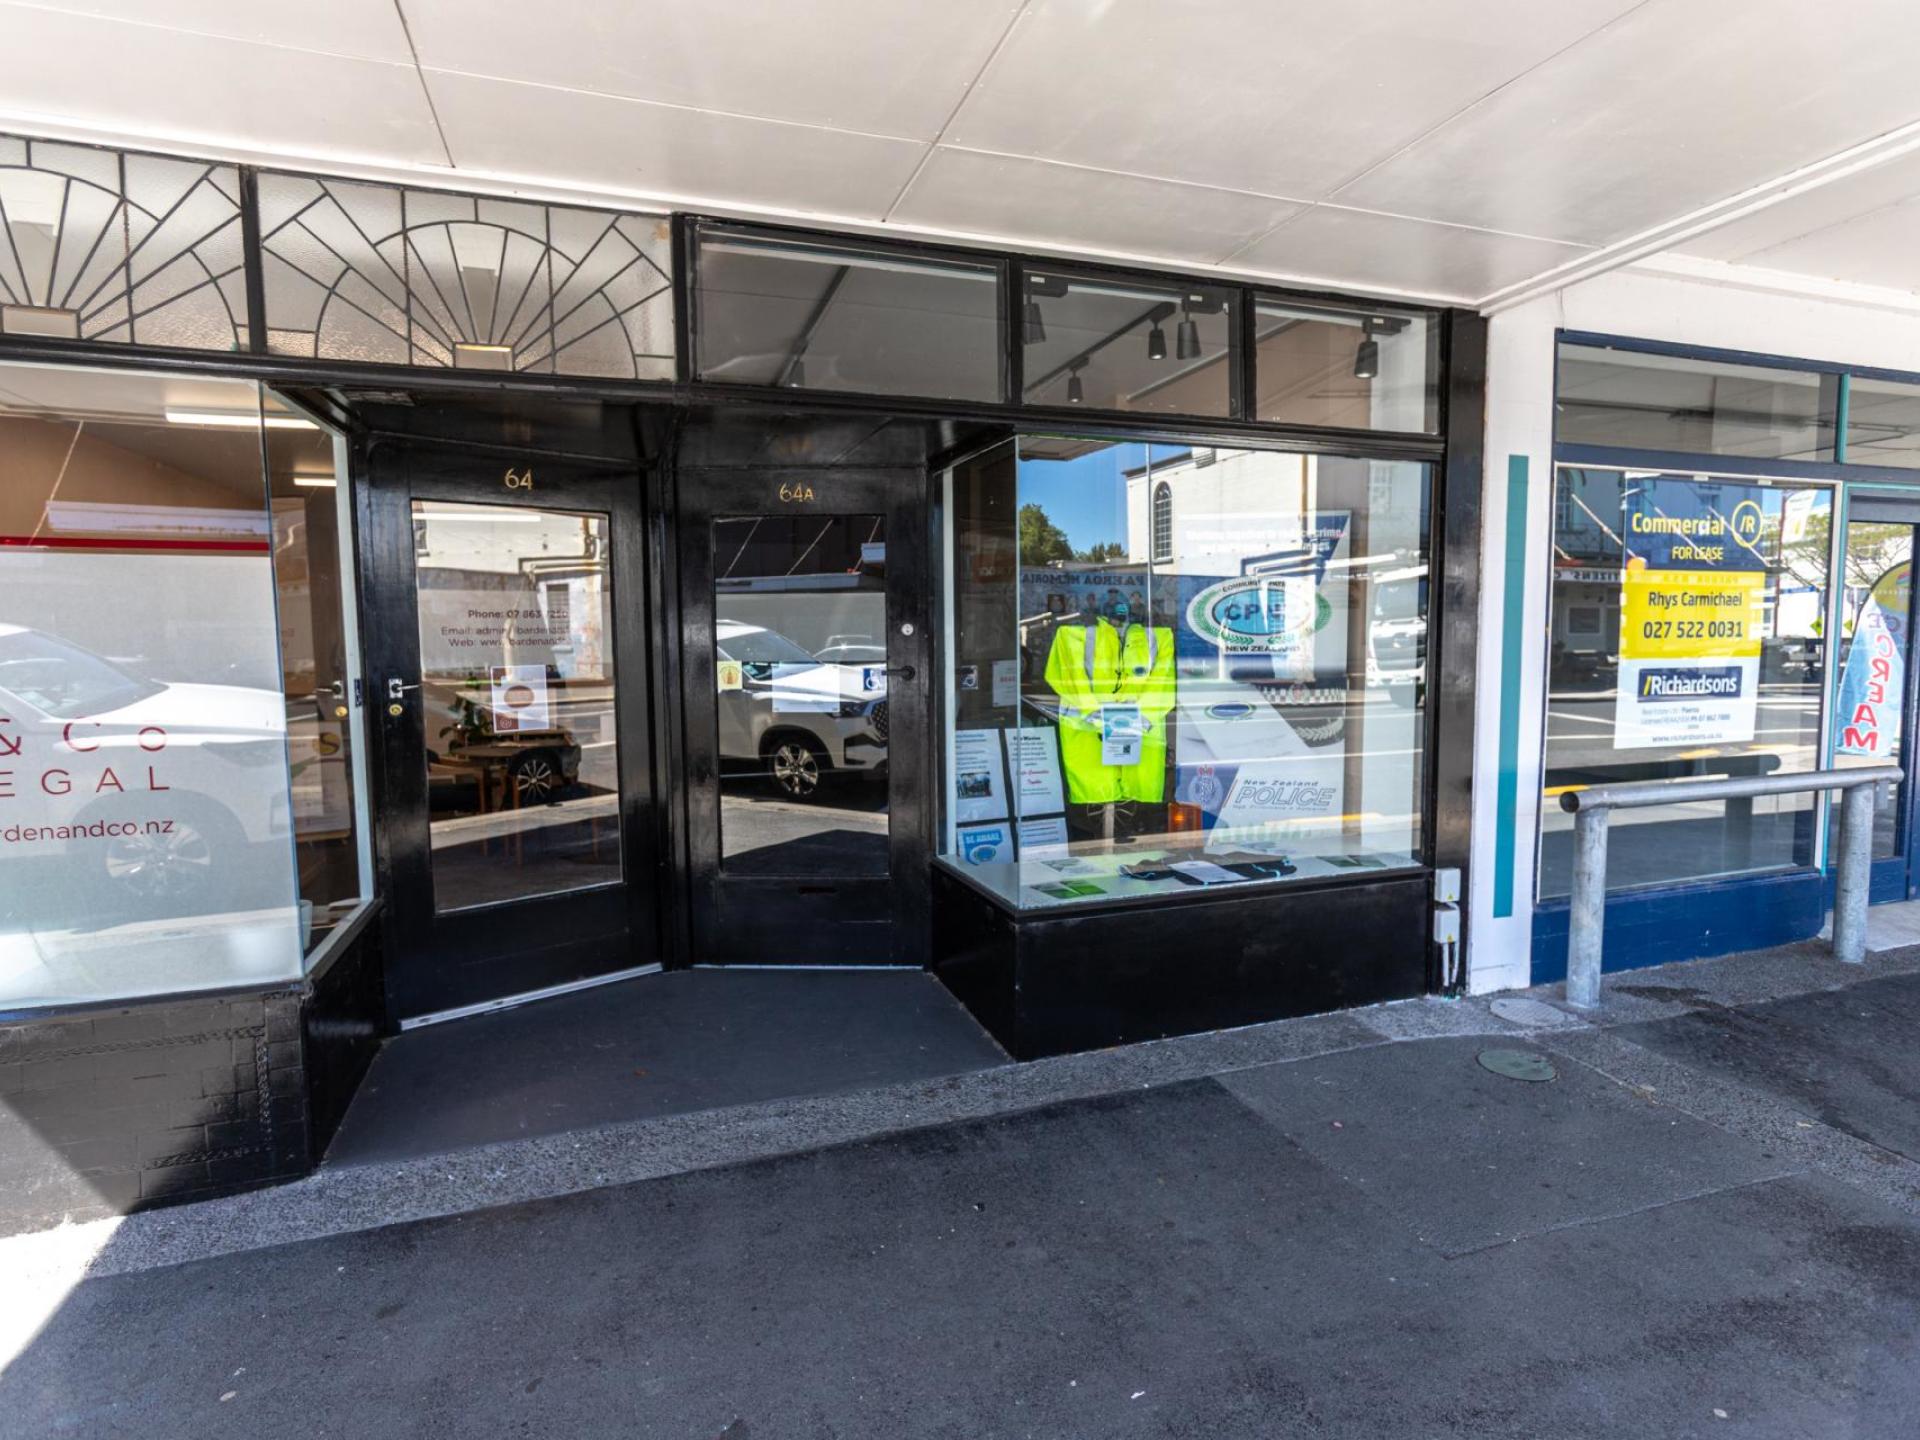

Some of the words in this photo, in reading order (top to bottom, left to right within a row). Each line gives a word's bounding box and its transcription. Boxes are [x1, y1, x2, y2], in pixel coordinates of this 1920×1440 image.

[504, 468, 534, 491] 64
[779, 482, 815, 502] 64A
[1631, 513, 1725, 536] Commercial
[1672, 546, 1693, 560] FOR
[1694, 547, 1724, 560] LEASE
[1648, 592, 1678, 609] Rhys
[1681, 592, 1743, 606] Carmichael
[468, 610, 503, 618] Phone:
[506, 610, 520, 619] 07
[441, 627, 471, 636] Email:
[1643, 622, 1672, 638] 027
[1677, 622, 1705, 638] 522
[1708, 621, 1743, 638] 0031
[448, 638, 474, 647] Web:
[1271, 780, 1319, 788] Zealand
[1235, 786, 1336, 807] POLICE
